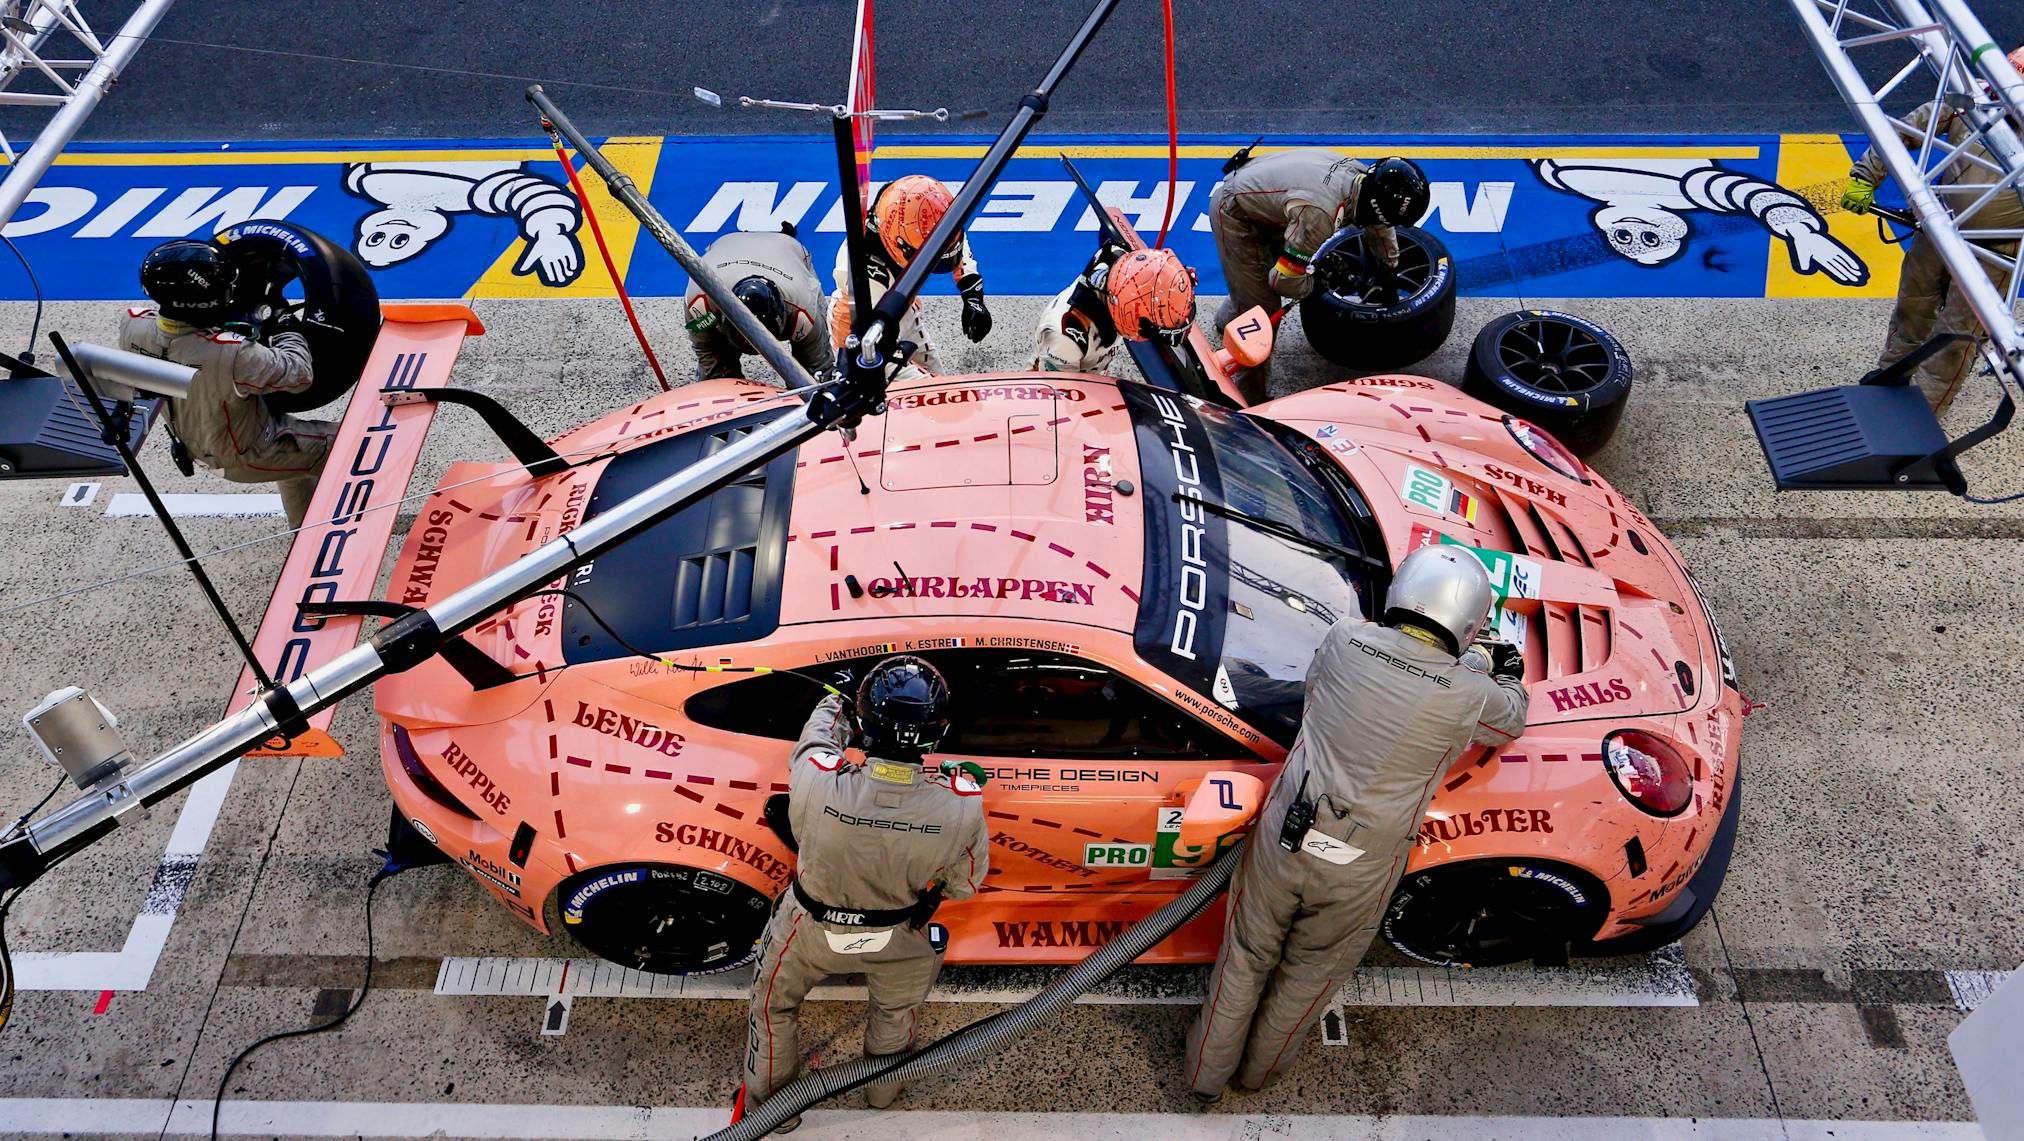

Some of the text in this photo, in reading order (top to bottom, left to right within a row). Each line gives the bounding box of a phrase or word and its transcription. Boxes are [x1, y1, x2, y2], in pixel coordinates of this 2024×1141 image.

[242, 223, 309, 254] MICHELIN
[187, 268, 211, 289] uvex
[716, 259, 794, 281] PORSCHE
[172, 298, 219, 310] uvex
[1414, 271, 1448, 307] MICHELIN
[1502, 378, 1556, 404] MICHELIN
[1082, 444, 1115, 525] HIRN
[1408, 469, 1444, 510] PRO
[1484, 463, 1568, 508] HALS
[1154, 393, 1207, 660] PORSCHE
[401, 509, 454, 611] SCHWA
[868, 577, 1095, 606] OHRLAPPEN
[826, 644, 883, 661] VANTHOOR
[918, 638, 952, 649] ESTRE
[990, 637, 1066, 652] CHRISTENSEN
[1348, 637, 1452, 689] PORSCHE
[1547, 678, 1632, 713] HALS
[572, 700, 686, 758] LENDE
[1175, 689, 1260, 744] www.porsche.com
[440, 741, 511, 816] RIPPLE
[1000, 784, 1080, 793] TIMEPIECES
[1060, 768, 1159, 783] DESIGN
[823, 805, 942, 835] PORSCHE
[469, 849, 506, 878] Mobil
[1087, 847, 1148, 865] PRO
[570, 871, 638, 909] MICHELIN
[1534, 872, 1586, 905] MICHELIN
[823, 909, 866, 925] MRTC
[992, 921, 1138, 948] WAMM
